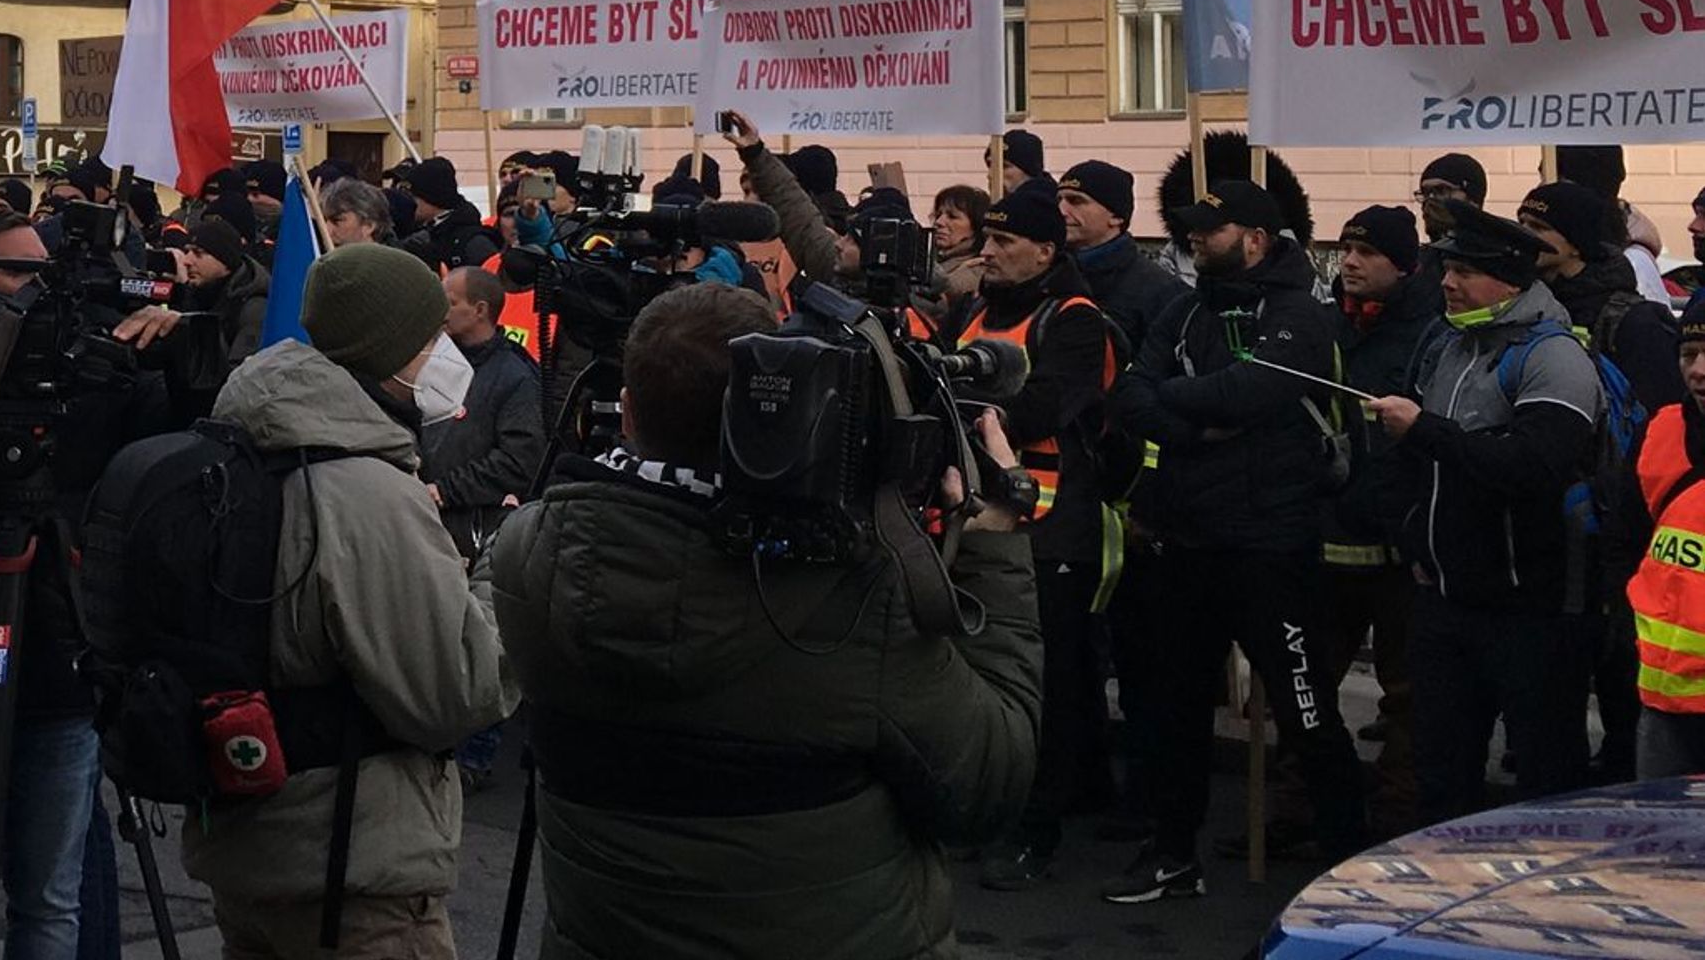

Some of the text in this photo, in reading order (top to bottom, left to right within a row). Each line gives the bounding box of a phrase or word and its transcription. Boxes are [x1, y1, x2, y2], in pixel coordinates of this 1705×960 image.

[495, 3, 598, 48] CHCEME
[723, 10, 779, 43] ODBORY
[784, 6, 835, 41] PROTI
[736, 40, 951, 90] A POVINNÉMU OČKOVÁNÍ
[1282, 621, 1320, 730] REPLAY
